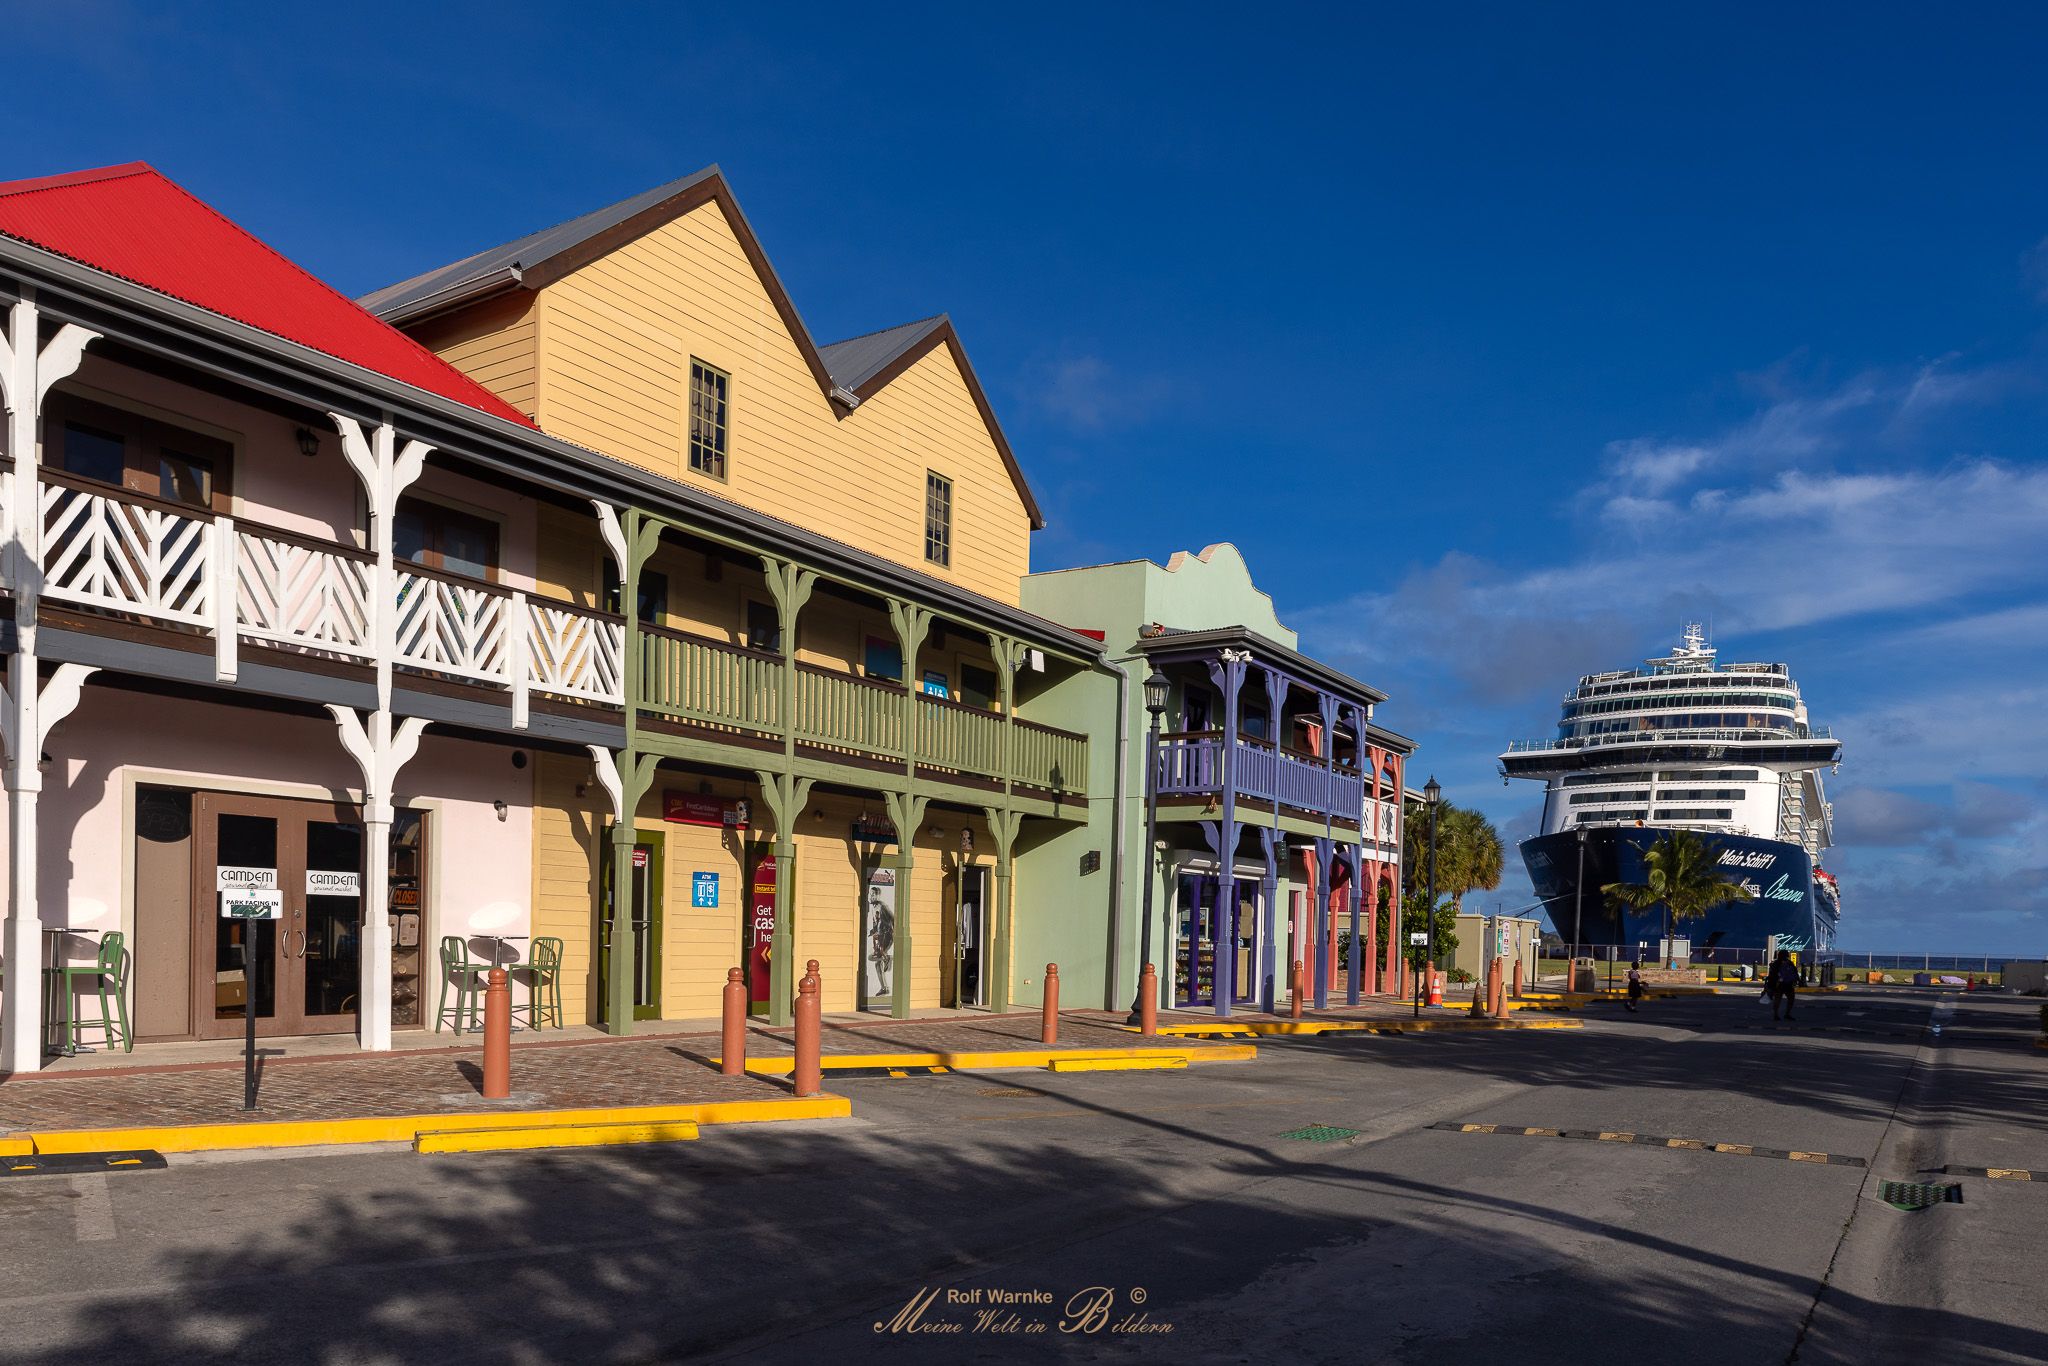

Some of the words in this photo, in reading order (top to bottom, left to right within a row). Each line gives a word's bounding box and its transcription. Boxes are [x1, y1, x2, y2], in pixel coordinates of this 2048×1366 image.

[1717, 848, 1745, 866] Mein
[1740, 851, 1773, 869] Schiff
[756, 904, 772, 916] Get
[755, 917, 775, 930] cas
[760, 931, 772, 942] he
